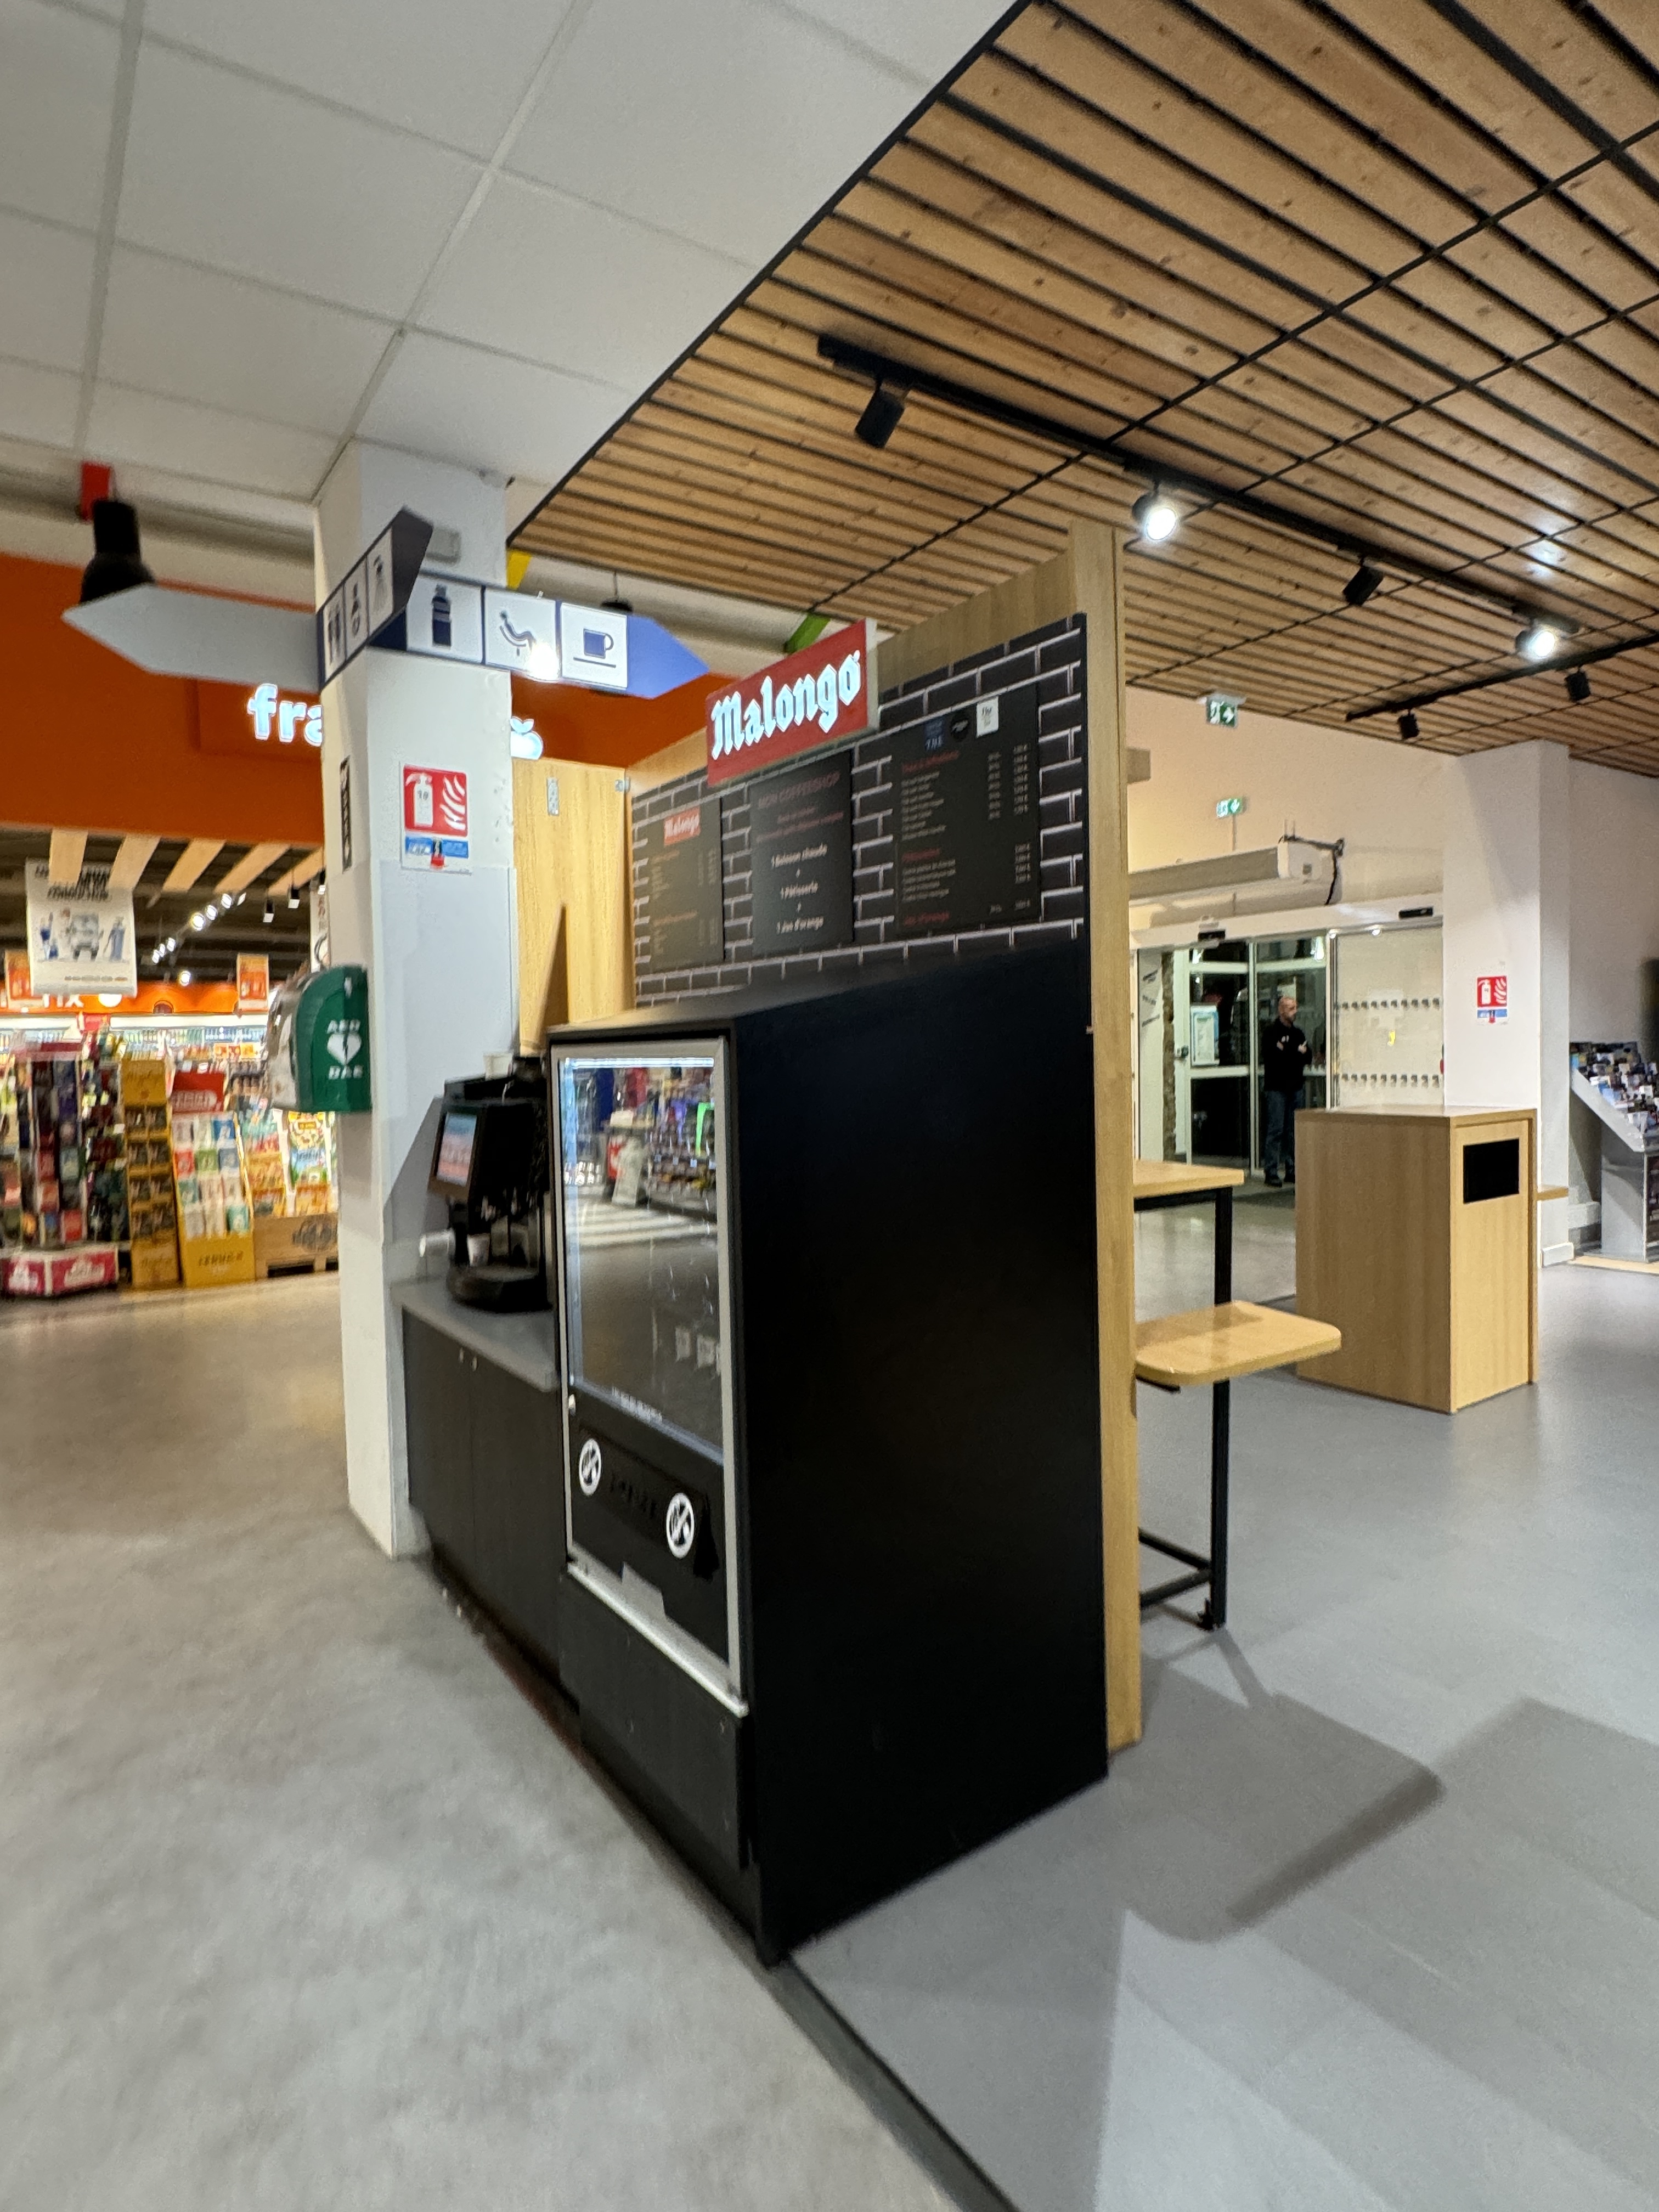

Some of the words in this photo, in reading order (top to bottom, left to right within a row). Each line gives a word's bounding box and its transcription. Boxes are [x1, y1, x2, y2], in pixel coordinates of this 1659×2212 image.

[711, 650, 861, 760] Malongo
[327, 1020, 361, 1034] AED
[329, 1065, 363, 1080] DAE
